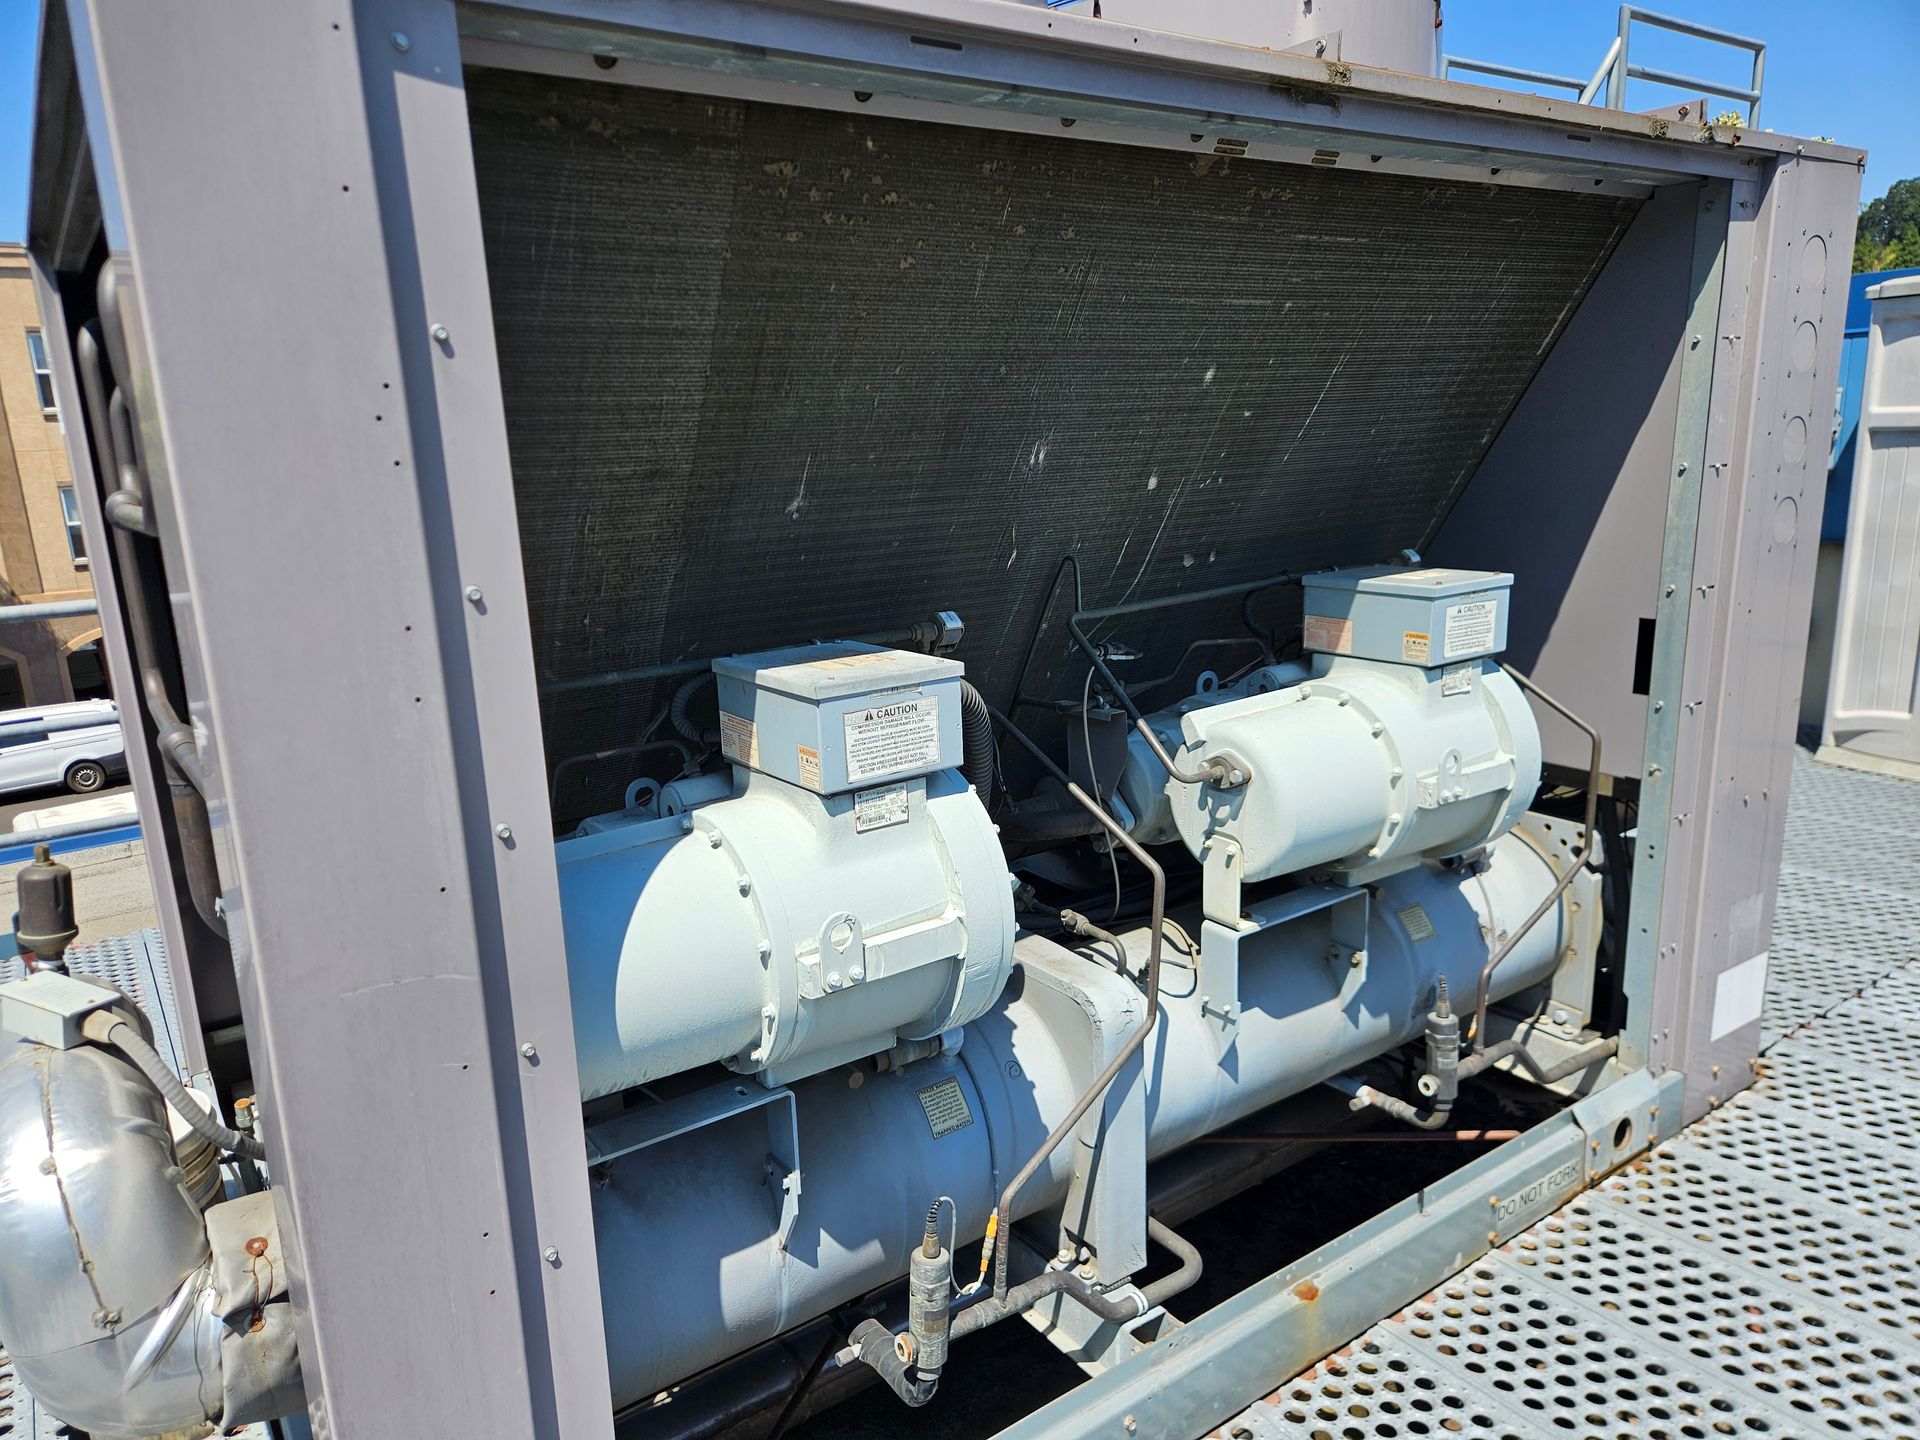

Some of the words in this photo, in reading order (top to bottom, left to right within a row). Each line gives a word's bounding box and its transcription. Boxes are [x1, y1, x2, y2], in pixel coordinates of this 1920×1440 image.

[1464, 604, 1486, 612] CAUTION
[877, 704, 918, 718] CAUTION
[851, 720, 883, 730] COMPRESSOR
[880, 720, 911, 730] REFRIGERANT
[935, 1079, 954, 1088] WARNING
[936, 1126, 955, 1136] TRAPPED
[1498, 1200, 1515, 1221] DO
[1519, 1181, 1545, 1208] NOT
[1548, 1164, 1578, 1190] FORK
